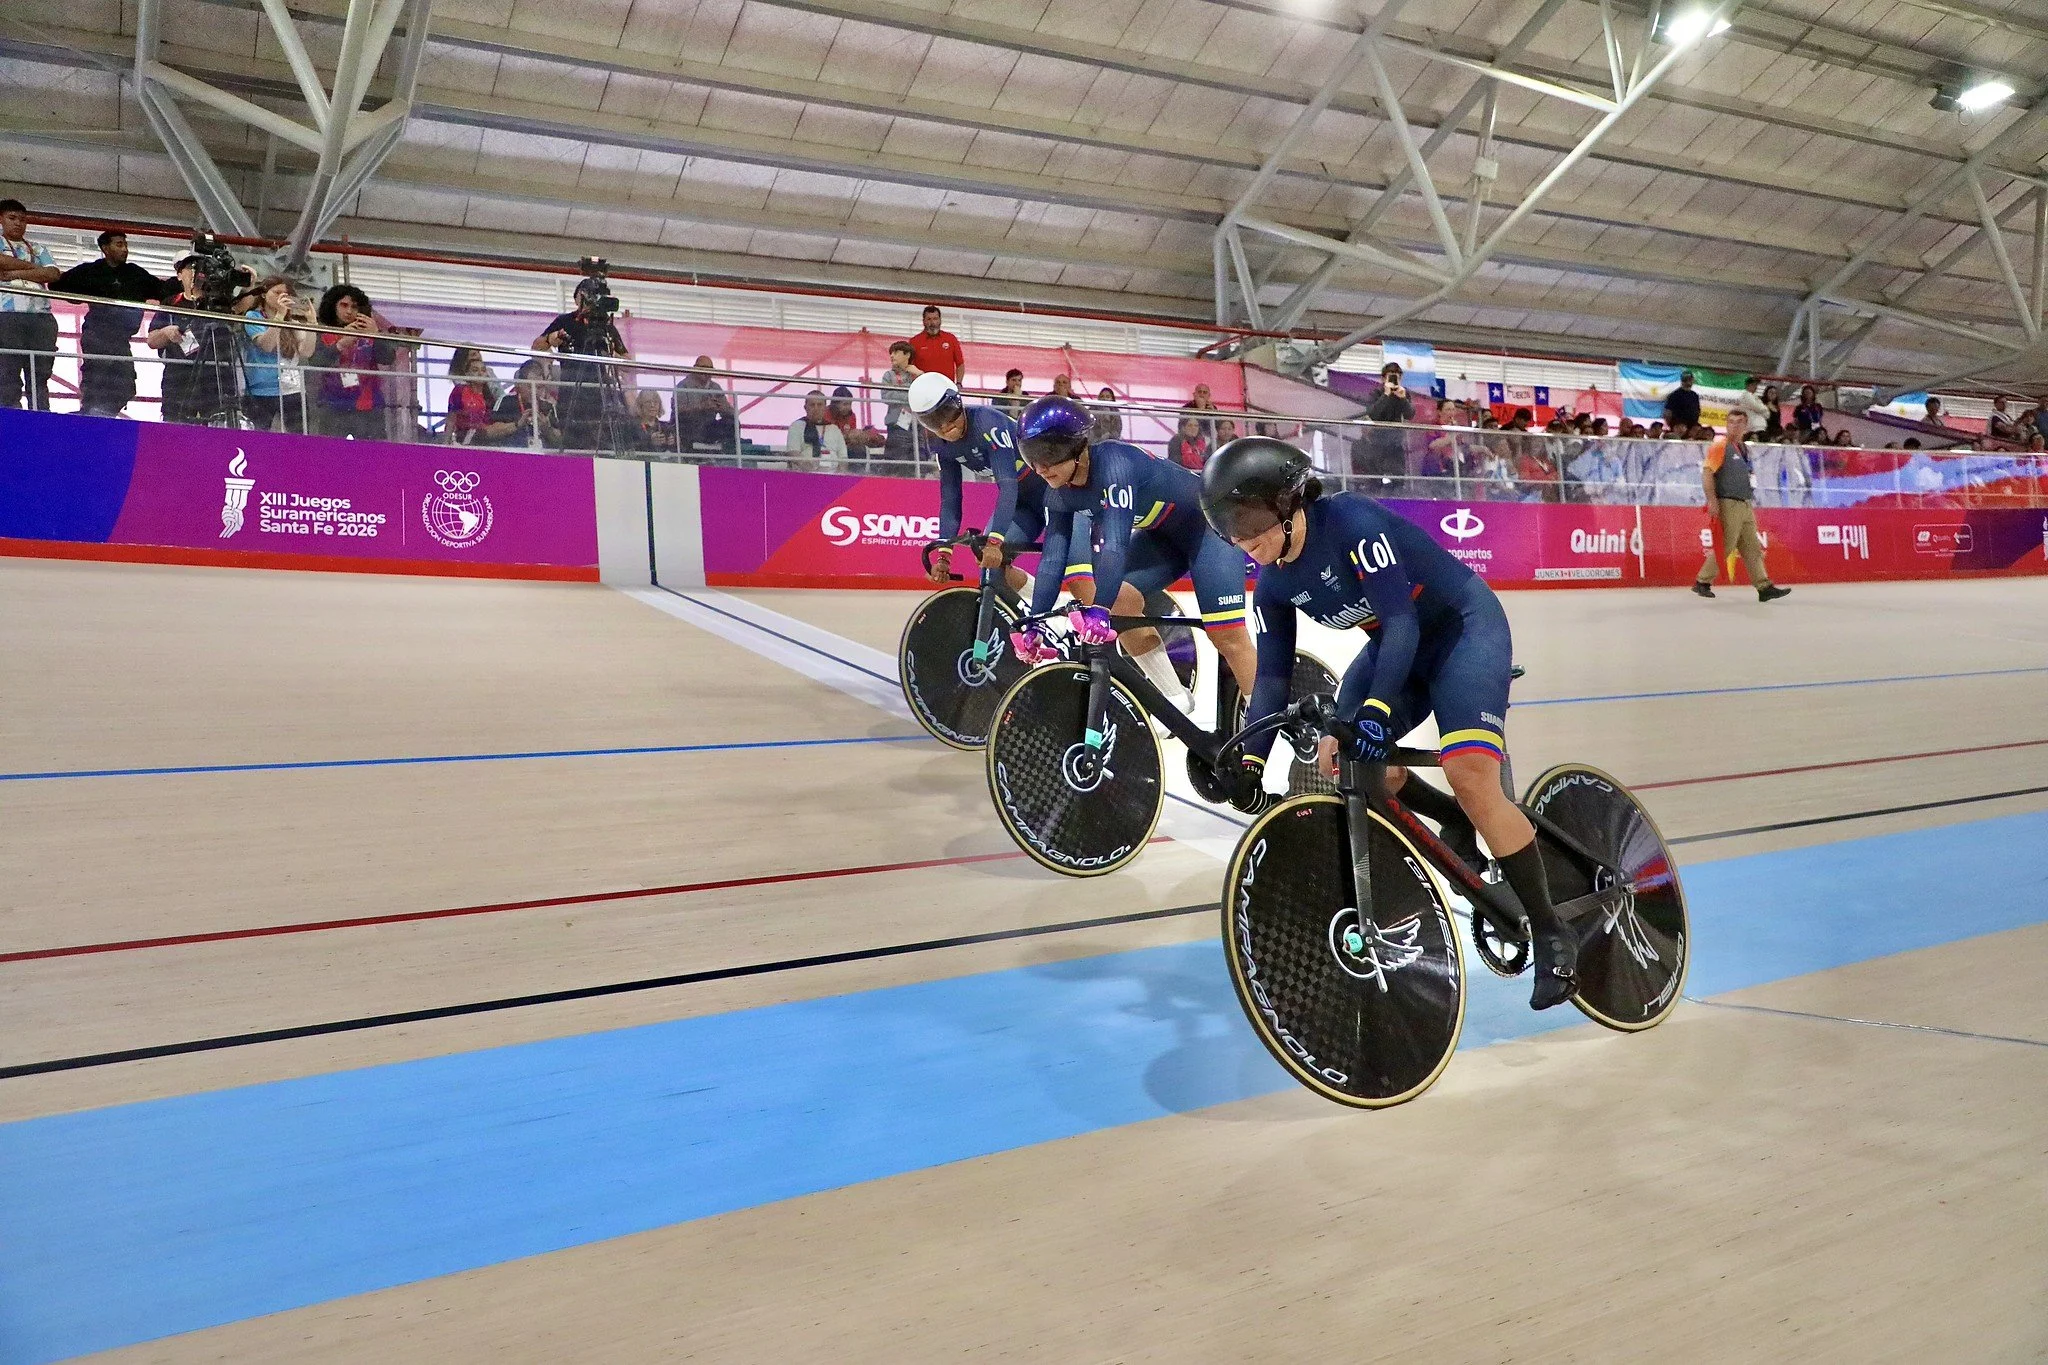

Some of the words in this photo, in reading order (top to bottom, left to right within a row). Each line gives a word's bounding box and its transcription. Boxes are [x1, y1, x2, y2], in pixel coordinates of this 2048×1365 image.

[260, 491, 287, 506] XIII
[290, 493, 351, 511] Juegos
[443, 492, 473, 500] ODESUR
[1108, 483, 1133, 509] Col
[260, 505, 387, 524] Suramericanos
[260, 519, 309, 535] Santa
[313, 522, 334, 535] Fe
[337, 523, 378, 537] 2026
[441, 538, 477, 549] DEPORTIVA
[1570, 529, 1626, 554] Quini
[1358, 533, 1397, 573] Col
[1534, 570, 1560, 578] JUNEK
[1571, 569, 1620, 578] VELODROMES
[1403, 856, 1458, 991] GHIBLI
[1238, 838, 1348, 1086] CAMPAGNOLO
[1643, 931, 1684, 1016] GHIBLI
